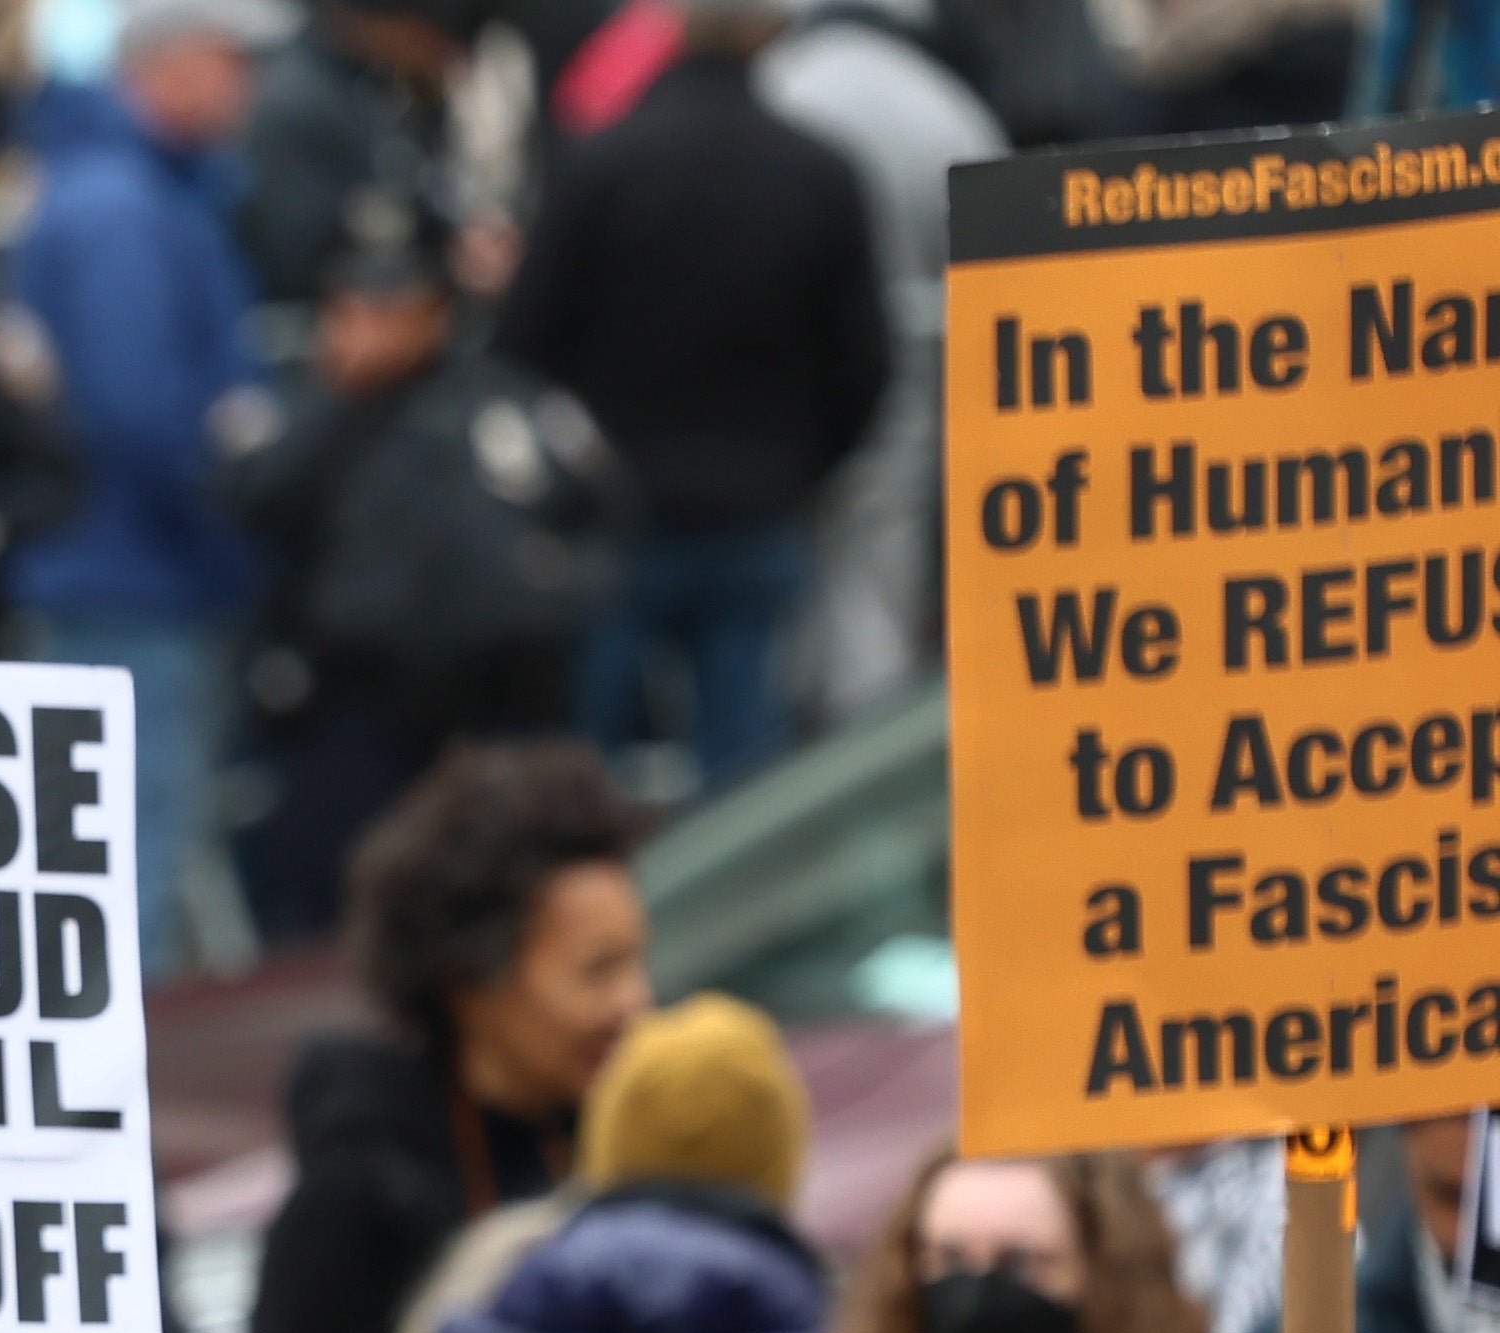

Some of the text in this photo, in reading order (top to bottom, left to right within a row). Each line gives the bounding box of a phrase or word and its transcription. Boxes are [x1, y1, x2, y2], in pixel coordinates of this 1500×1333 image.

[994, 280, 1500, 411] In the Na
[980, 450, 1088, 552] of
[1014, 548, 1500, 686] We REFU
[1068, 730, 1175, 820] to
[1082, 885, 1141, 958] a
